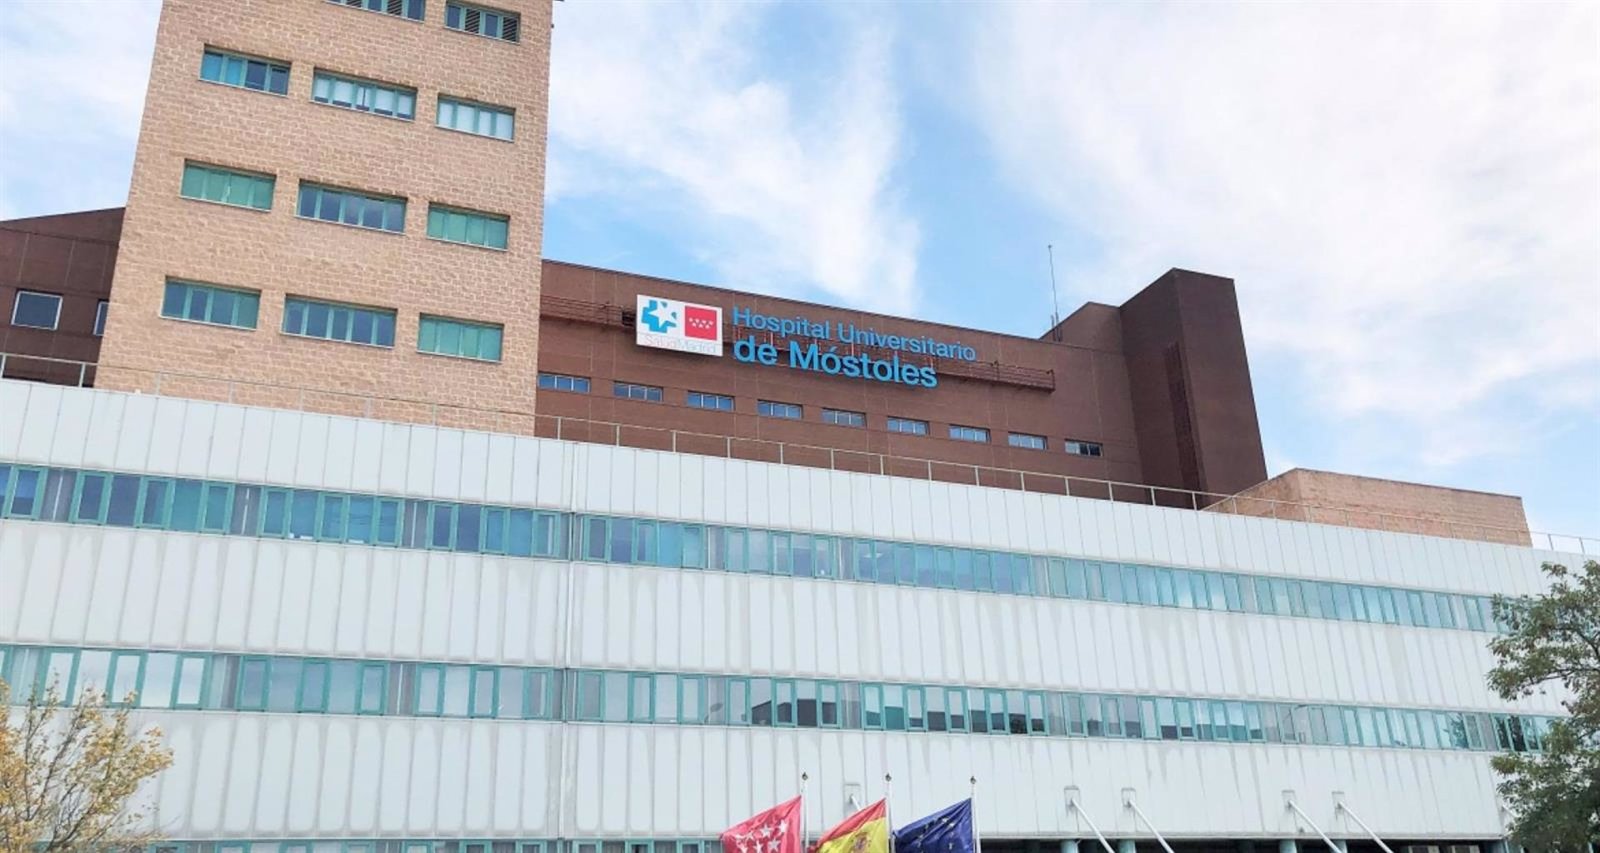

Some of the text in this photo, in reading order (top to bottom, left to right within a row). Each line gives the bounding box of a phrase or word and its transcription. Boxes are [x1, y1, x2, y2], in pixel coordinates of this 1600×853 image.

[733, 307, 976, 361] Hospital Universitario
[734, 336, 938, 388] de Móstoles
